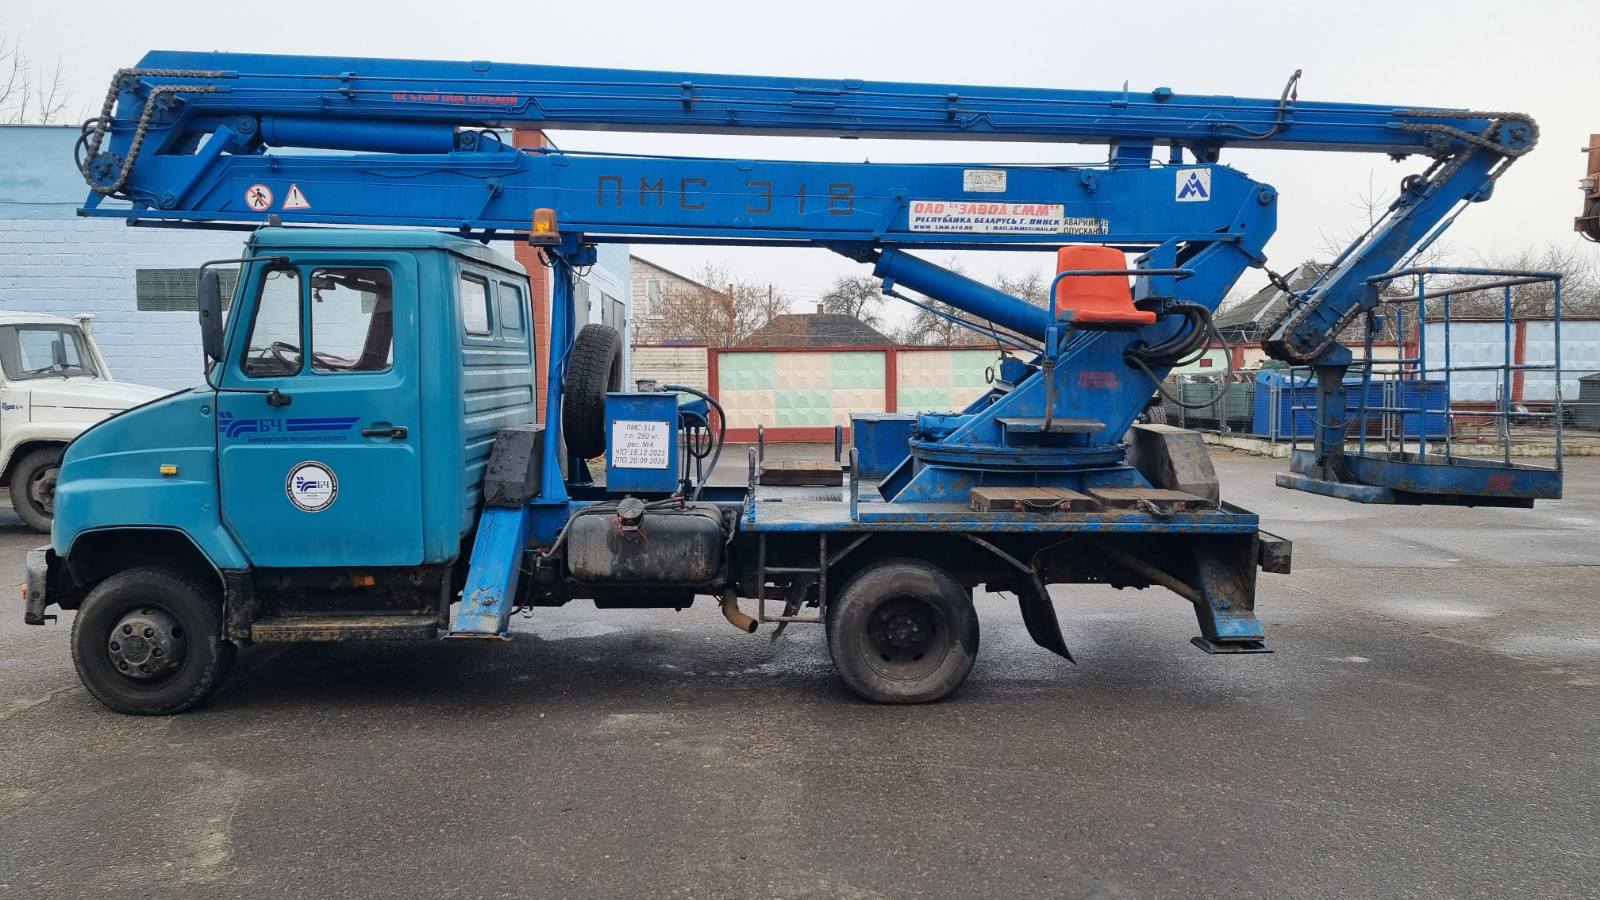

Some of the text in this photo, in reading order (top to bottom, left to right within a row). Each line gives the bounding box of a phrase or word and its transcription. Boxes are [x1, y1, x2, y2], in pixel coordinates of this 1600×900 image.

[597, 175, 854, 216] ПМС 318
[913, 202, 944, 214] ОАО
[914, 215, 972, 224] РЕСПУБЛИКА
[974, 217, 1018, 225] БЕЛАРУСЬ
[1029, 218, 1061, 226] ПИНСК
[258, 419, 283, 432] БЧ
[317, 481, 330, 489] БЧ
